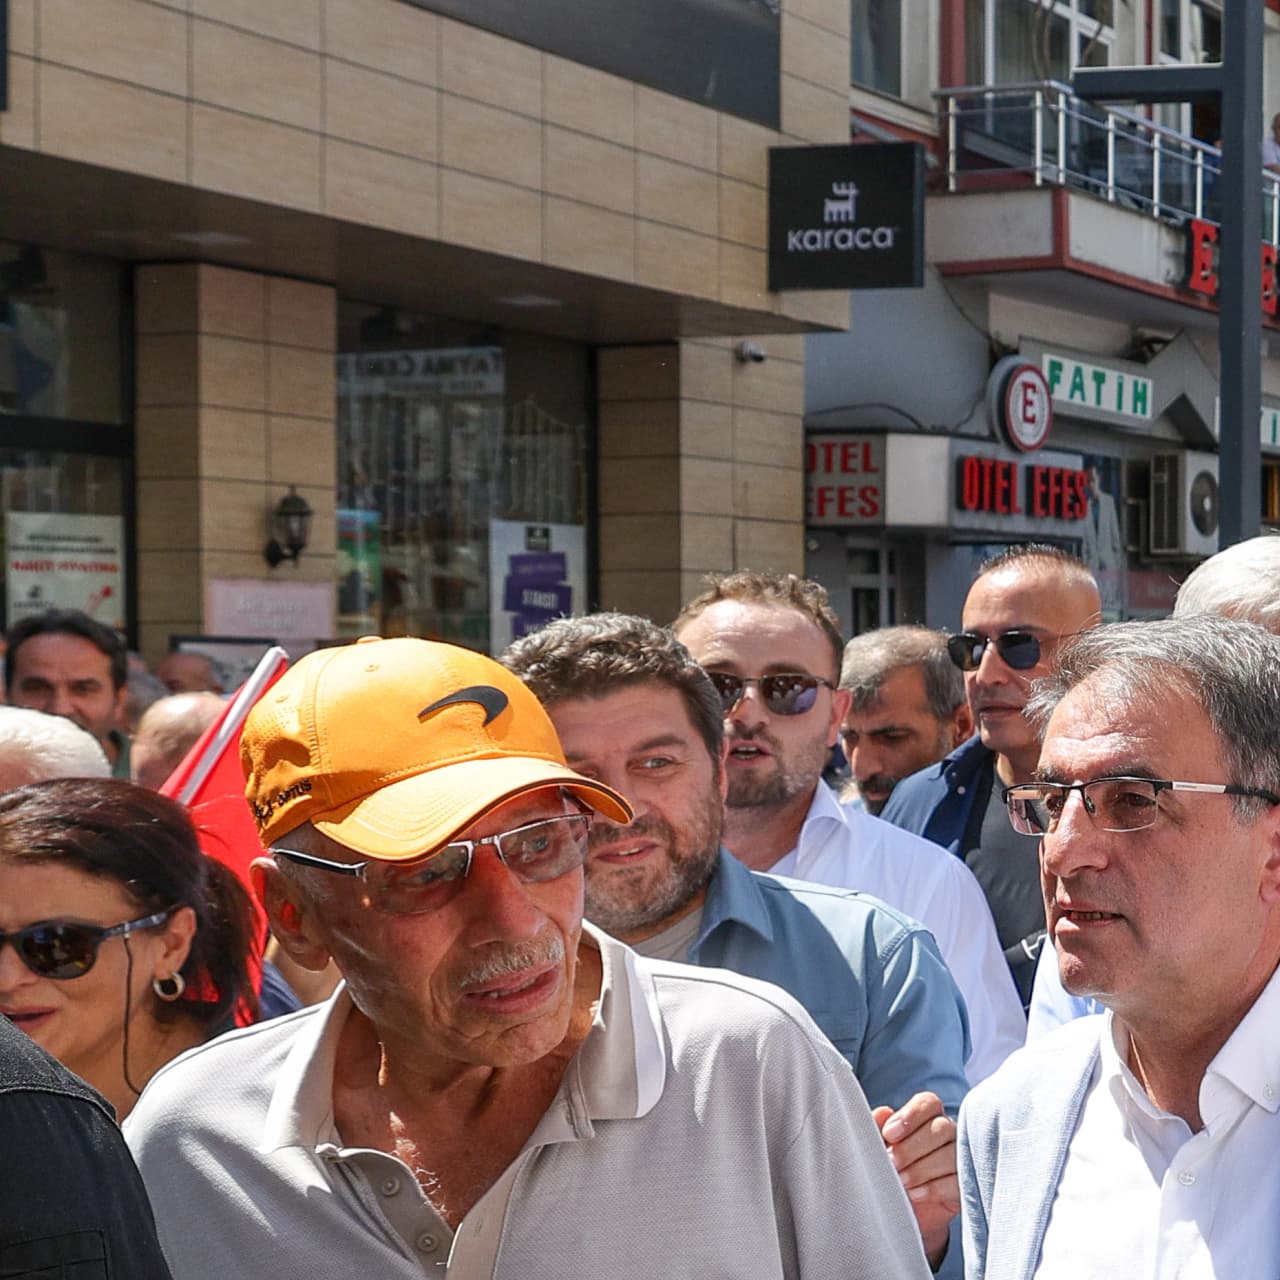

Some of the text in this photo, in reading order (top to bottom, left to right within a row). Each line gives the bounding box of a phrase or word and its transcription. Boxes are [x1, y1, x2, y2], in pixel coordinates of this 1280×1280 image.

[787, 226, 894, 251] karaca
[1021, 381, 1037, 424] E
[963, 455, 1089, 520] OTEL EFES
